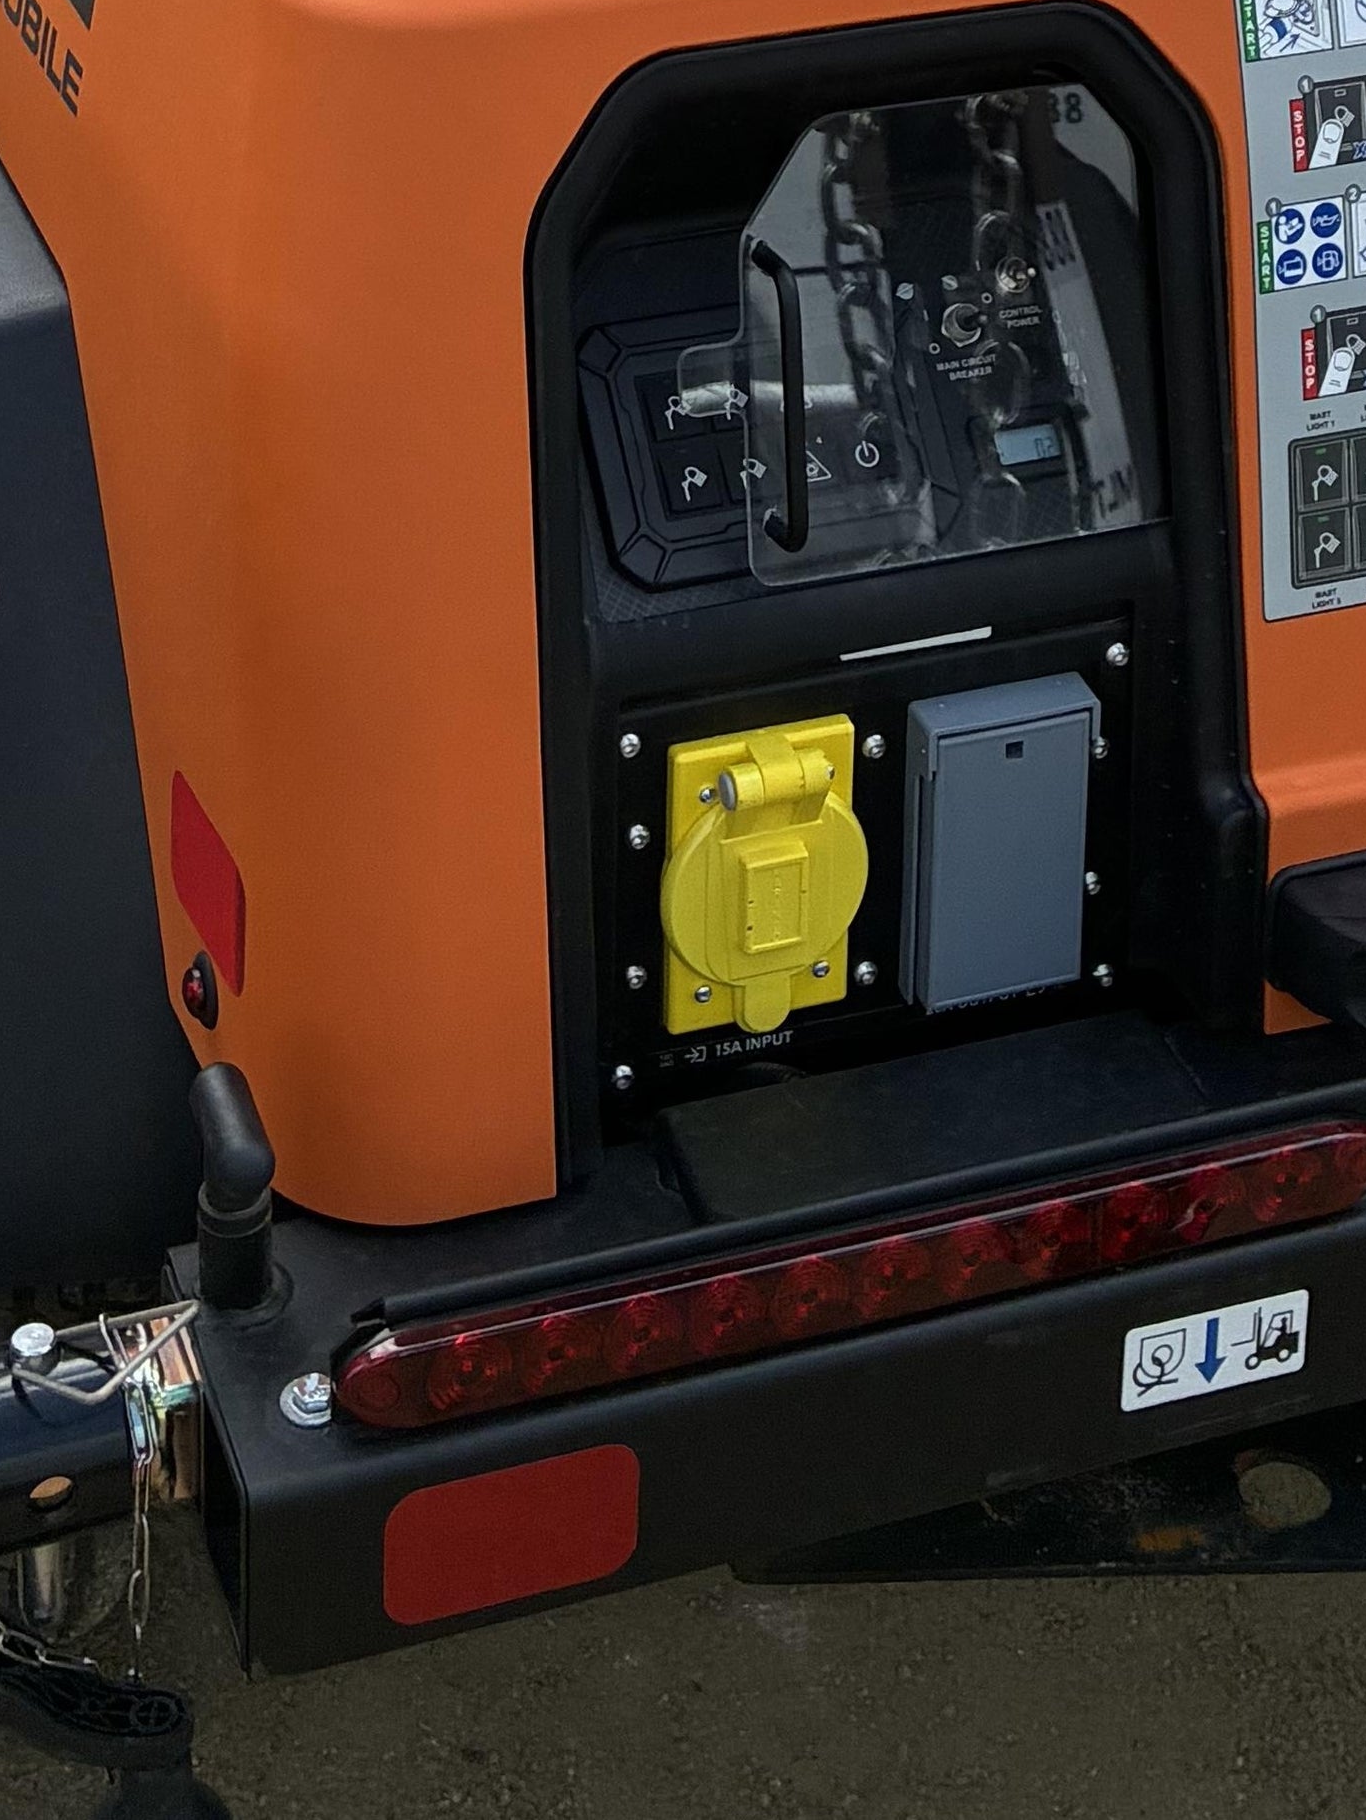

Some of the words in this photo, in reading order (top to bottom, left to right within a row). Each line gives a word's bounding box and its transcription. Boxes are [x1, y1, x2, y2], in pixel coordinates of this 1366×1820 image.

[1293, 109, 1304, 161] STOP
[1258, 225, 1272, 290] START
[1303, 338, 1317, 390] STOP
[714, 1040, 742, 1058] 15A
[745, 1030, 793, 1052] INPUT
